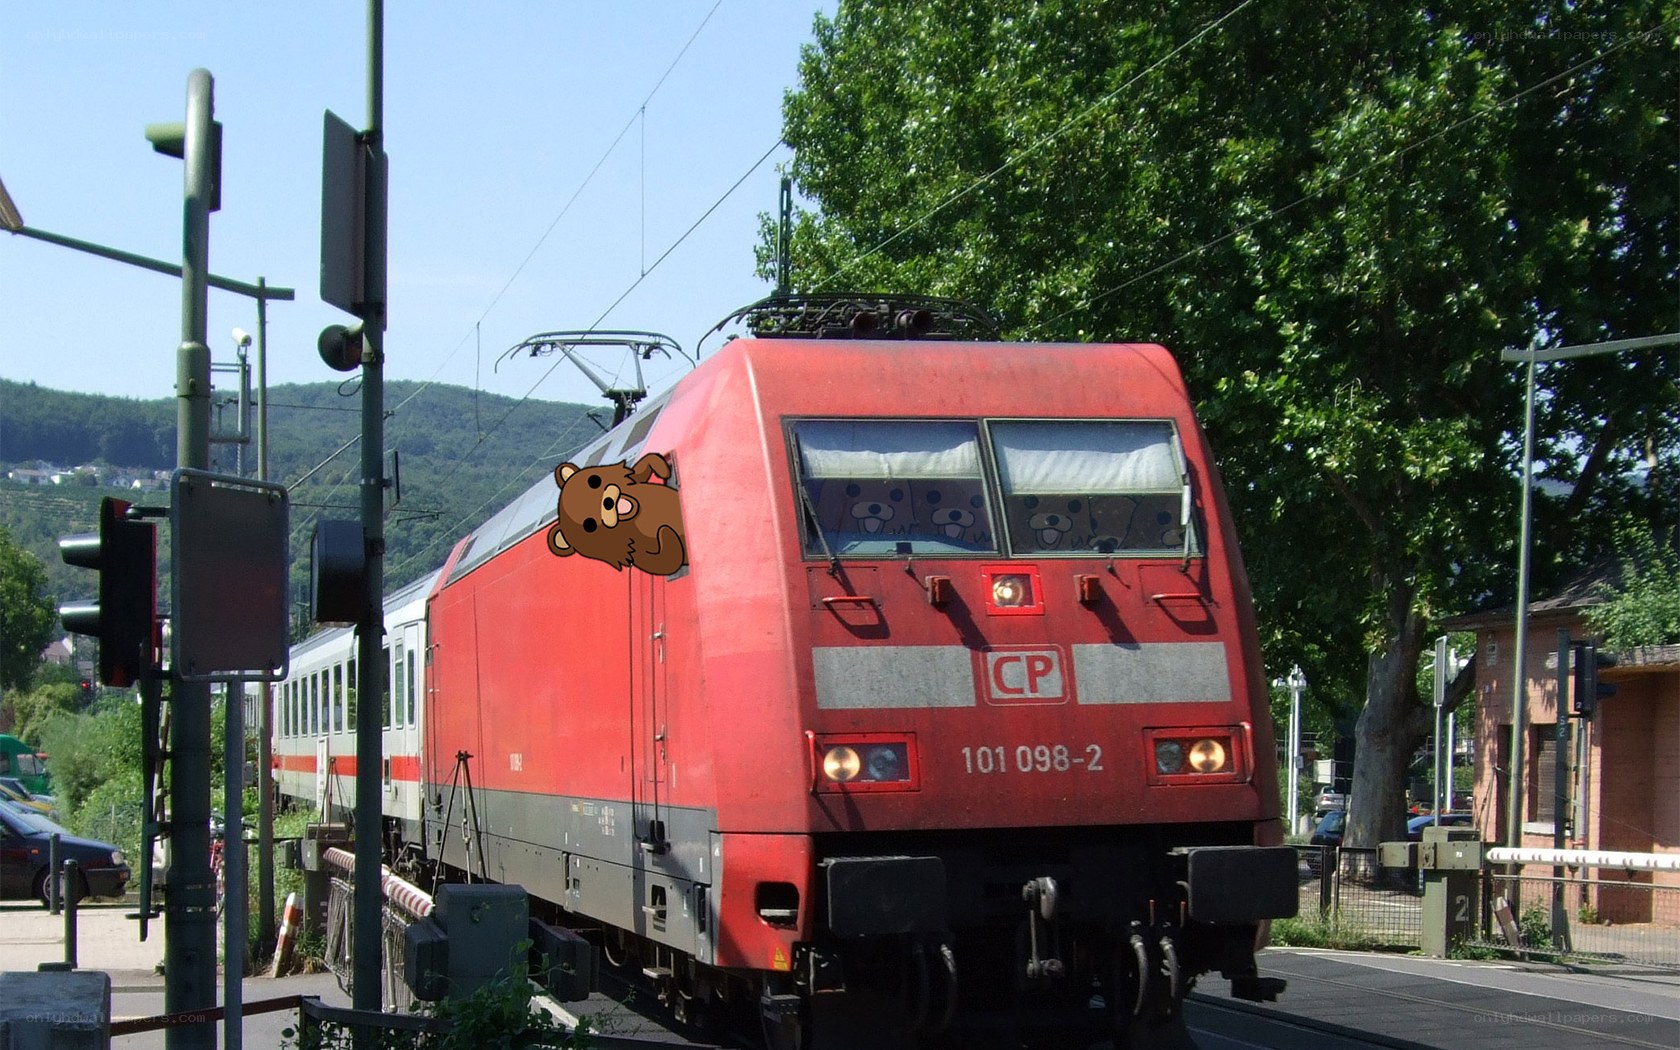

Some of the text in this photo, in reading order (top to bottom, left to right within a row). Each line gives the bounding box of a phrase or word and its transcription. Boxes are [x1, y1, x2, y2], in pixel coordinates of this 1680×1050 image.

[993, 655, 1053, 694] CP
[961, 743, 1103, 774] 101 098-2
[1455, 895, 1469, 921] 2
